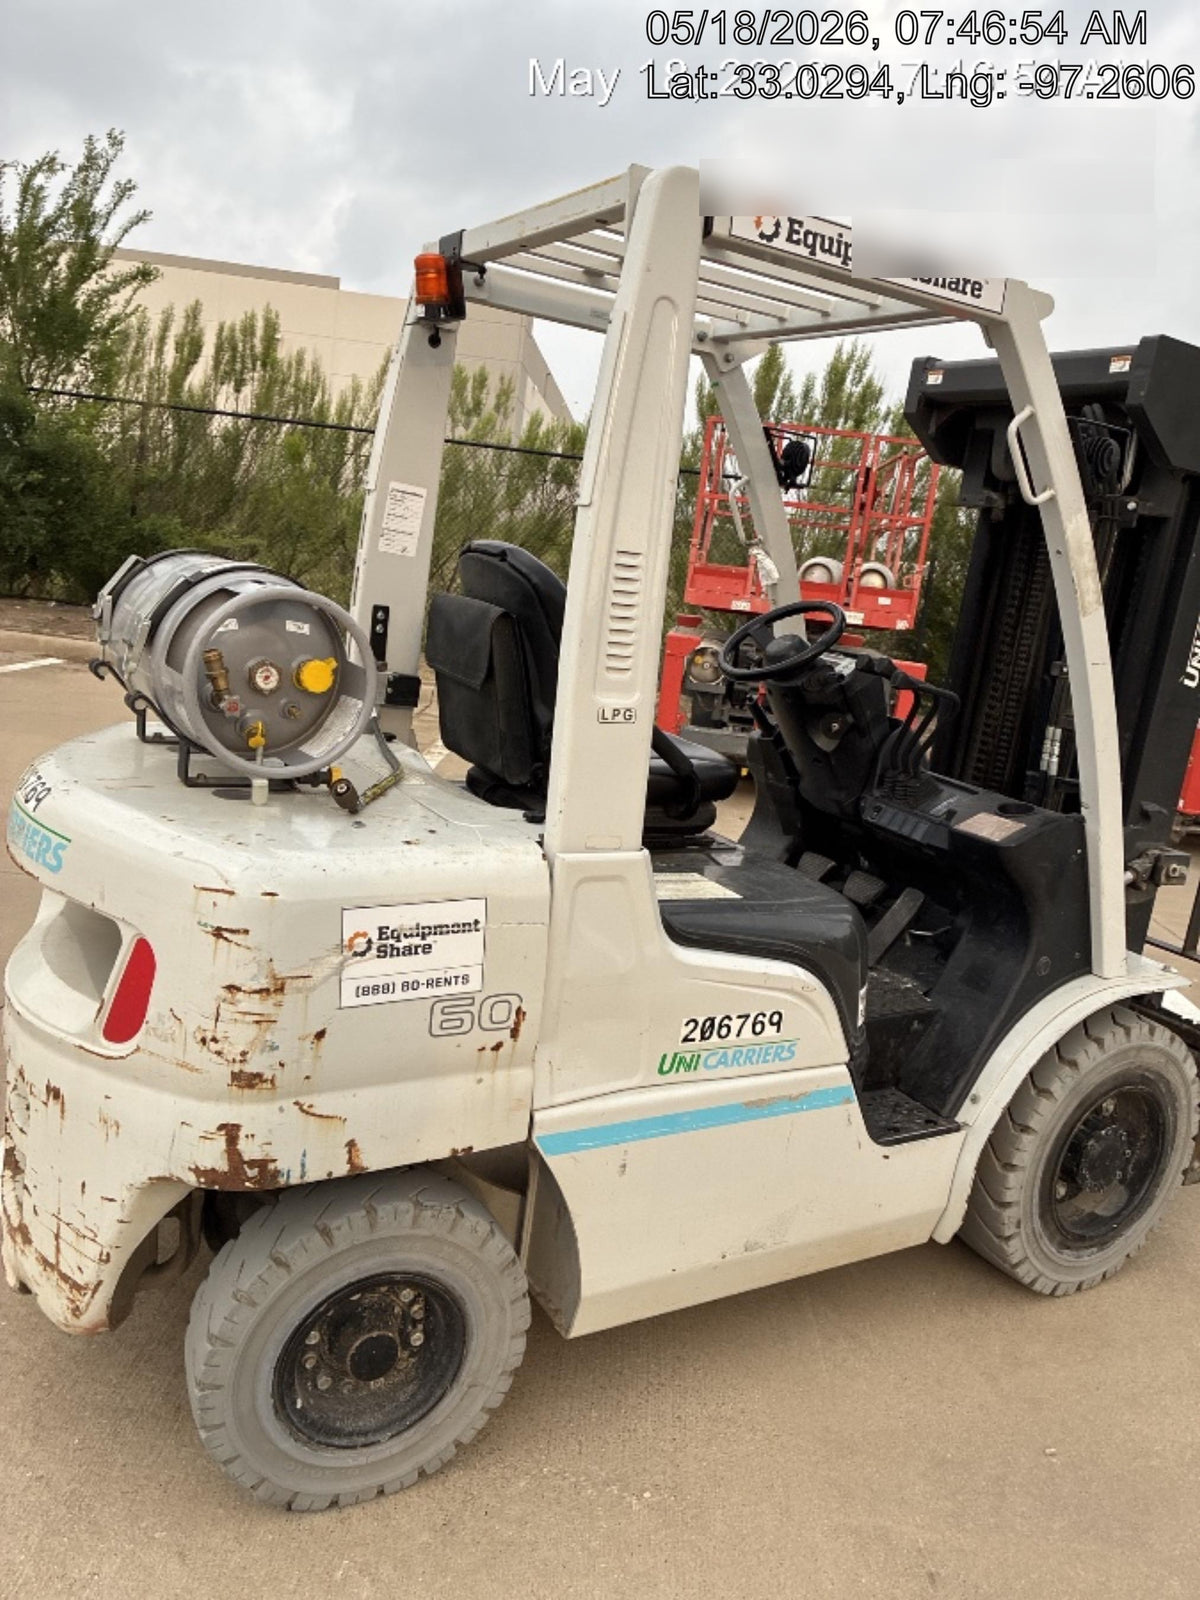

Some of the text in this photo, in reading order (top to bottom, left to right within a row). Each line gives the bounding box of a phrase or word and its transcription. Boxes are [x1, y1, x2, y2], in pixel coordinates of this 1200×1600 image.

[600, 708, 634, 721] LPG
[376, 918, 481, 943] Equipment
[376, 942, 433, 959] Share
[355, 981, 396, 998] (888)
[428, 993, 523, 1038] 60
[681, 1010, 784, 1044] 206769
